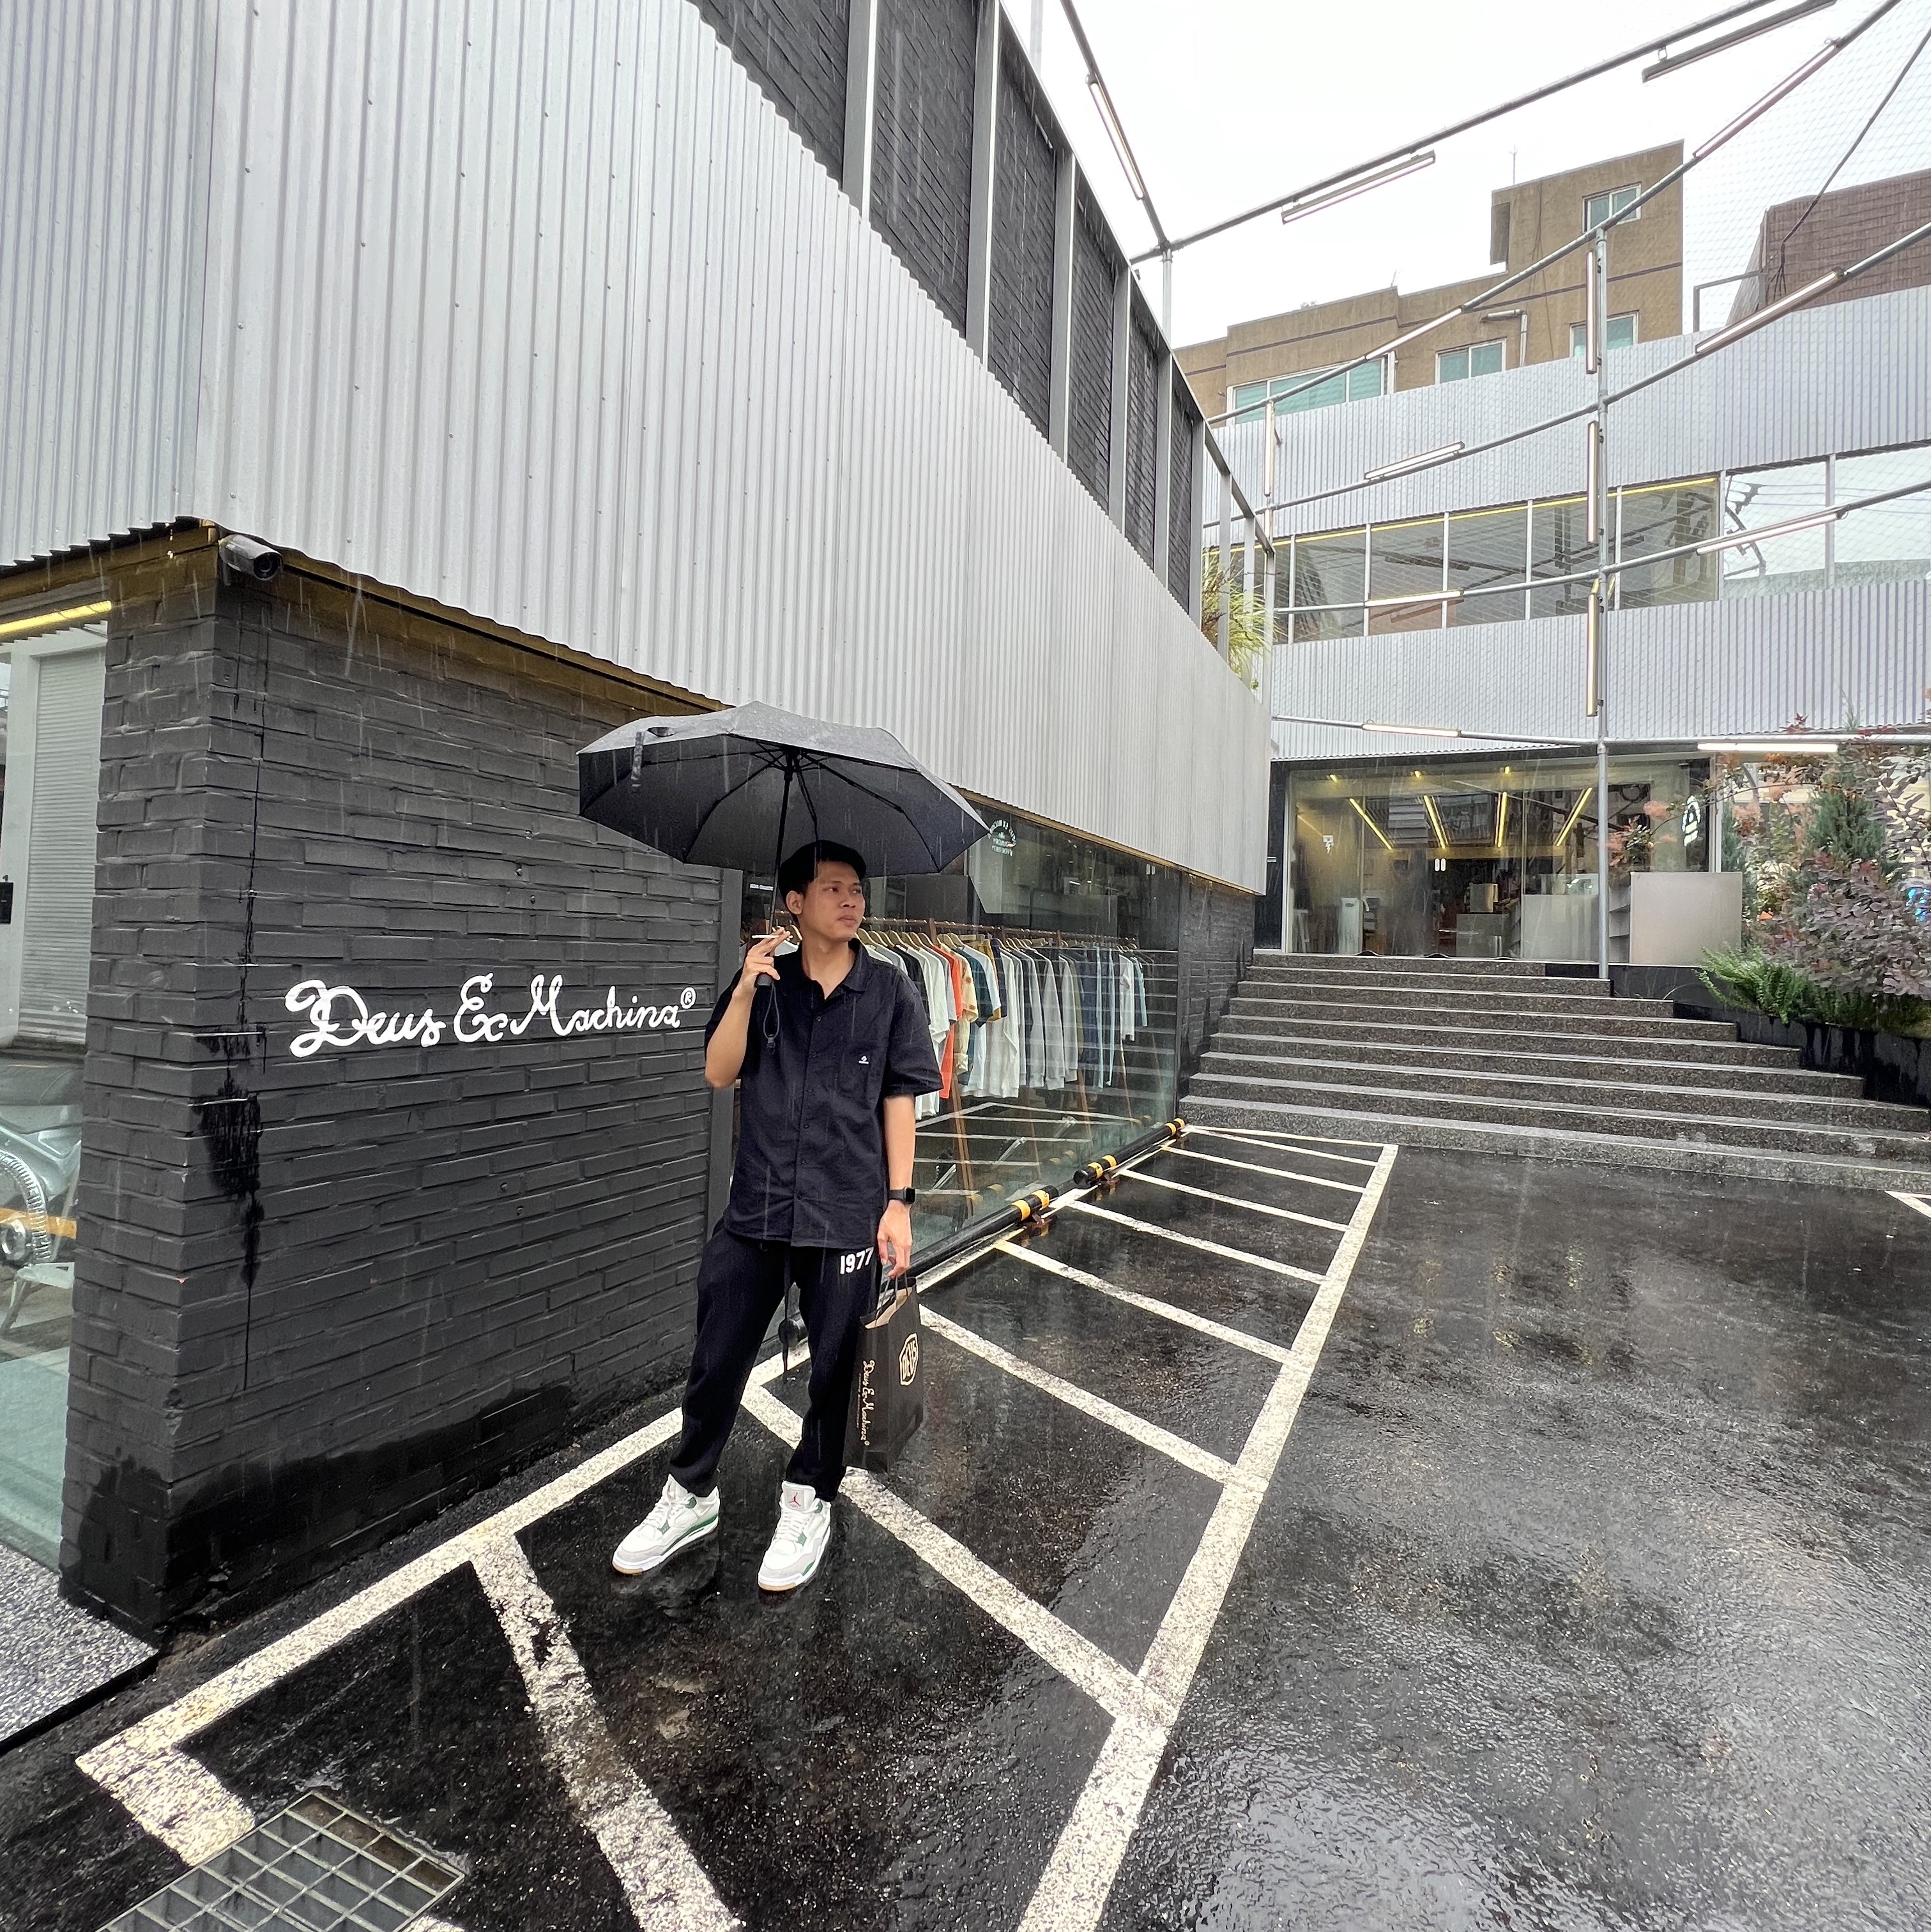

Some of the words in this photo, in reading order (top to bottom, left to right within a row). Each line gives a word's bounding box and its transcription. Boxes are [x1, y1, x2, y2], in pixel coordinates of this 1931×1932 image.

[284, 979, 446, 1058] Deus
[453, 972, 508, 1042] Ex
[839, 1247, 874, 1275] 1977
[862, 1360, 875, 1387] Deus
[901, 1339, 918, 1381] DEUS
